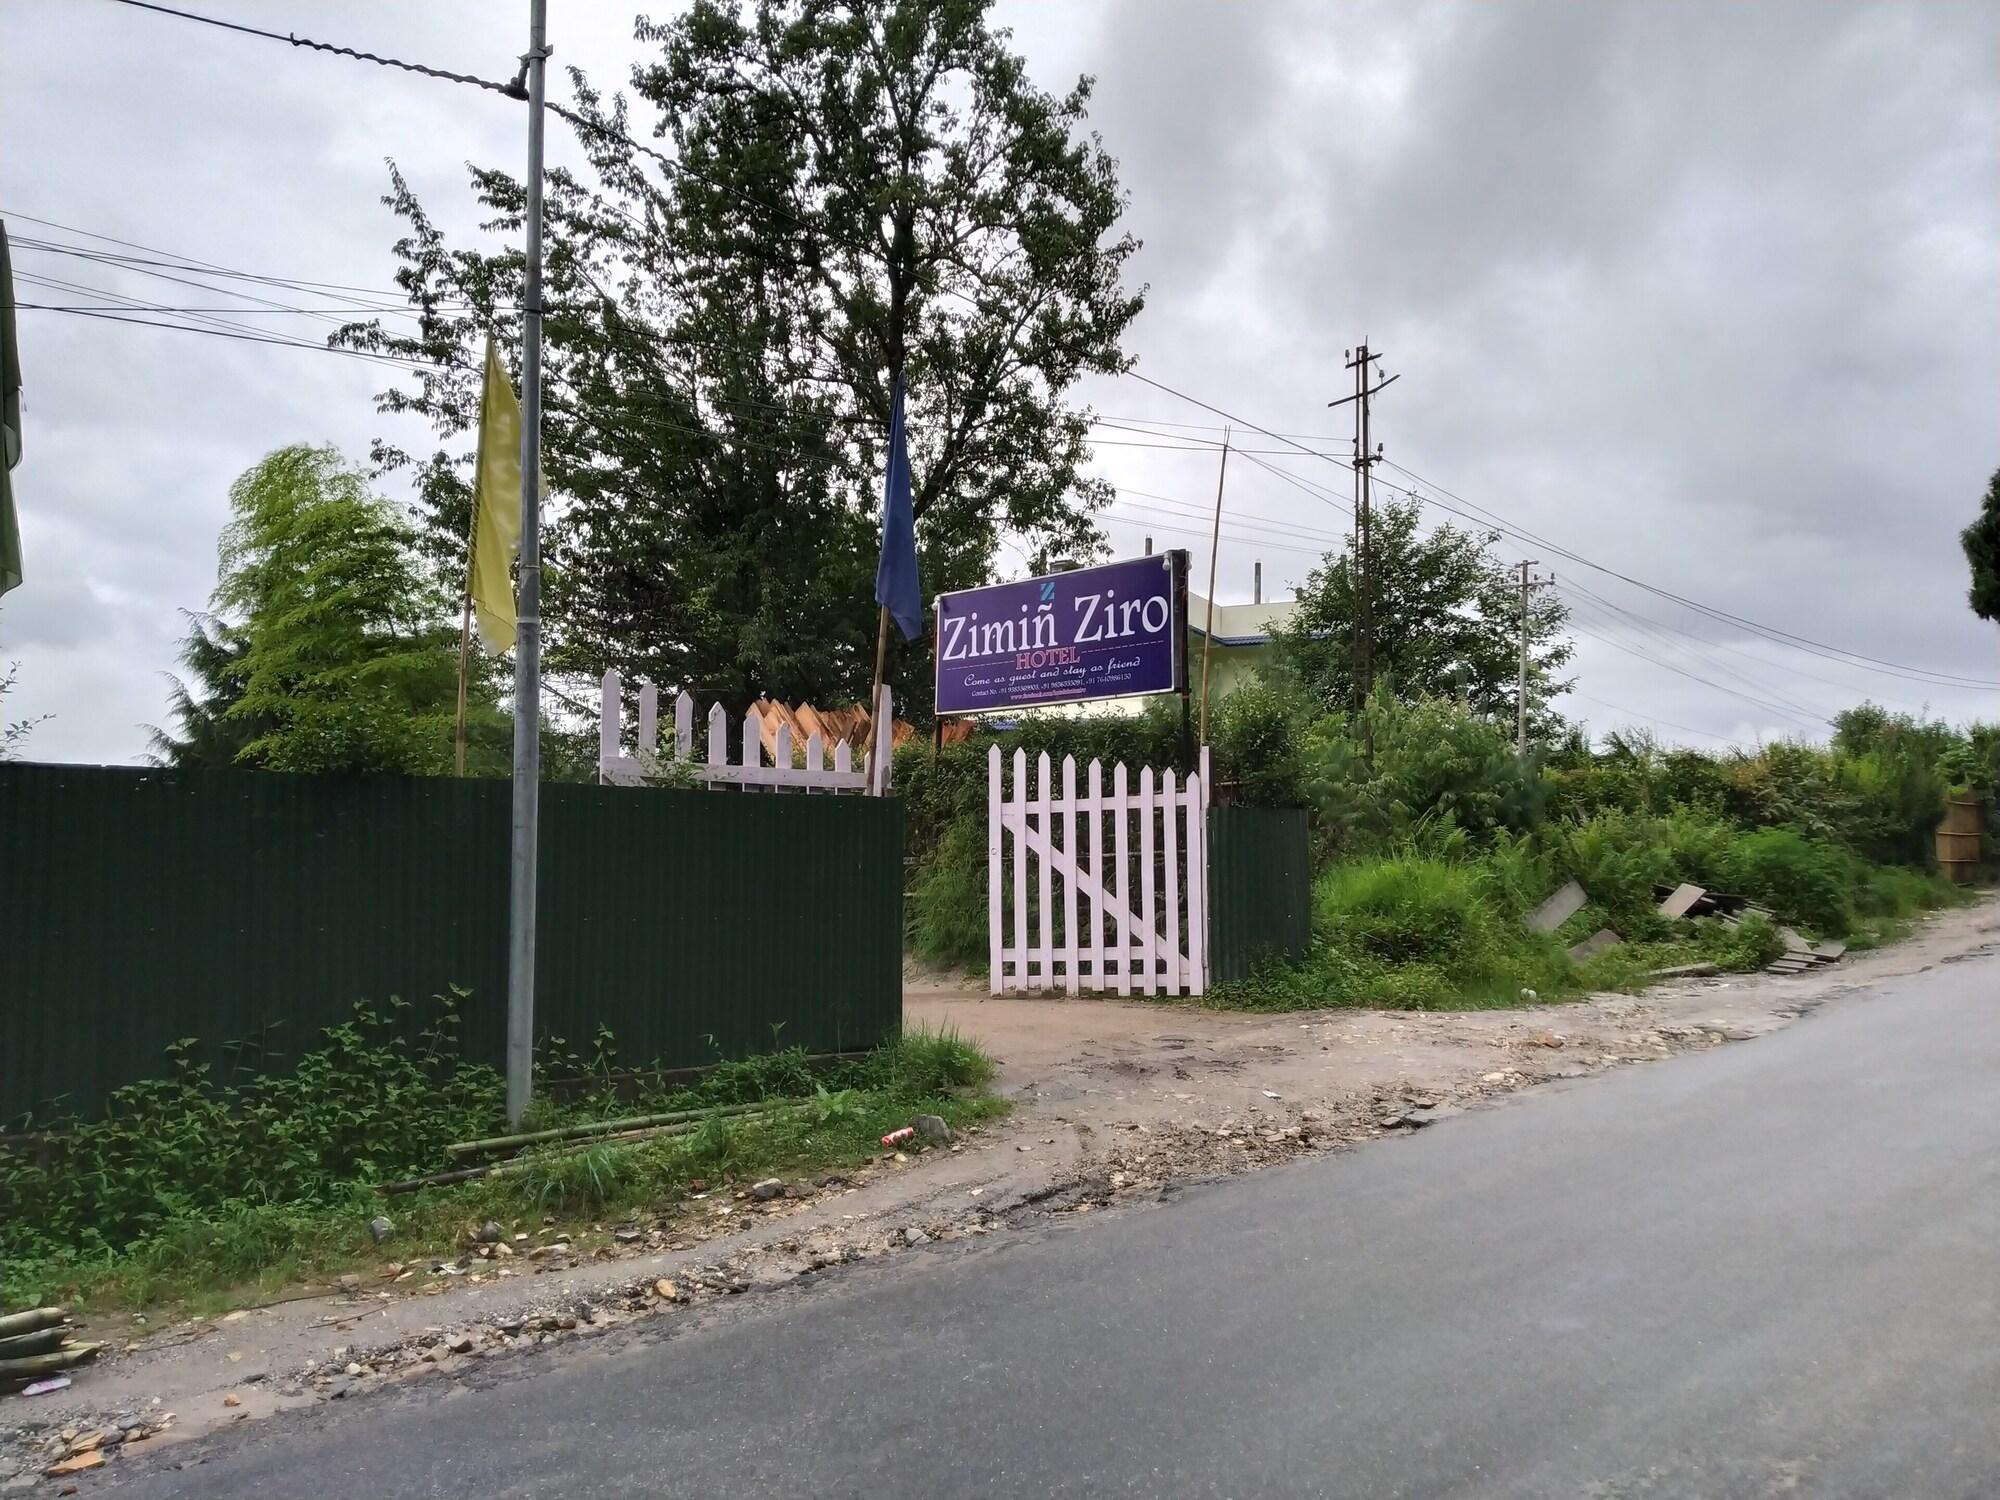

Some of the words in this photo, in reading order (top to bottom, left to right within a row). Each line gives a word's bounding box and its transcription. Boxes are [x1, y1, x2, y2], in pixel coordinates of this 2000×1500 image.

[942, 603, 1058, 661] Zimiñ
[1073, 589, 1169, 643] Ziro
[964, 673, 990, 686] Come
[1009, 670, 1036, 686] guest
[1040, 667, 1060, 677] and
[1063, 665, 1086, 678] stay
[1105, 656, 1140, 675] friend
[1016, 646, 1081, 670] HOTEL
[971, 689, 989, 697] Contact
